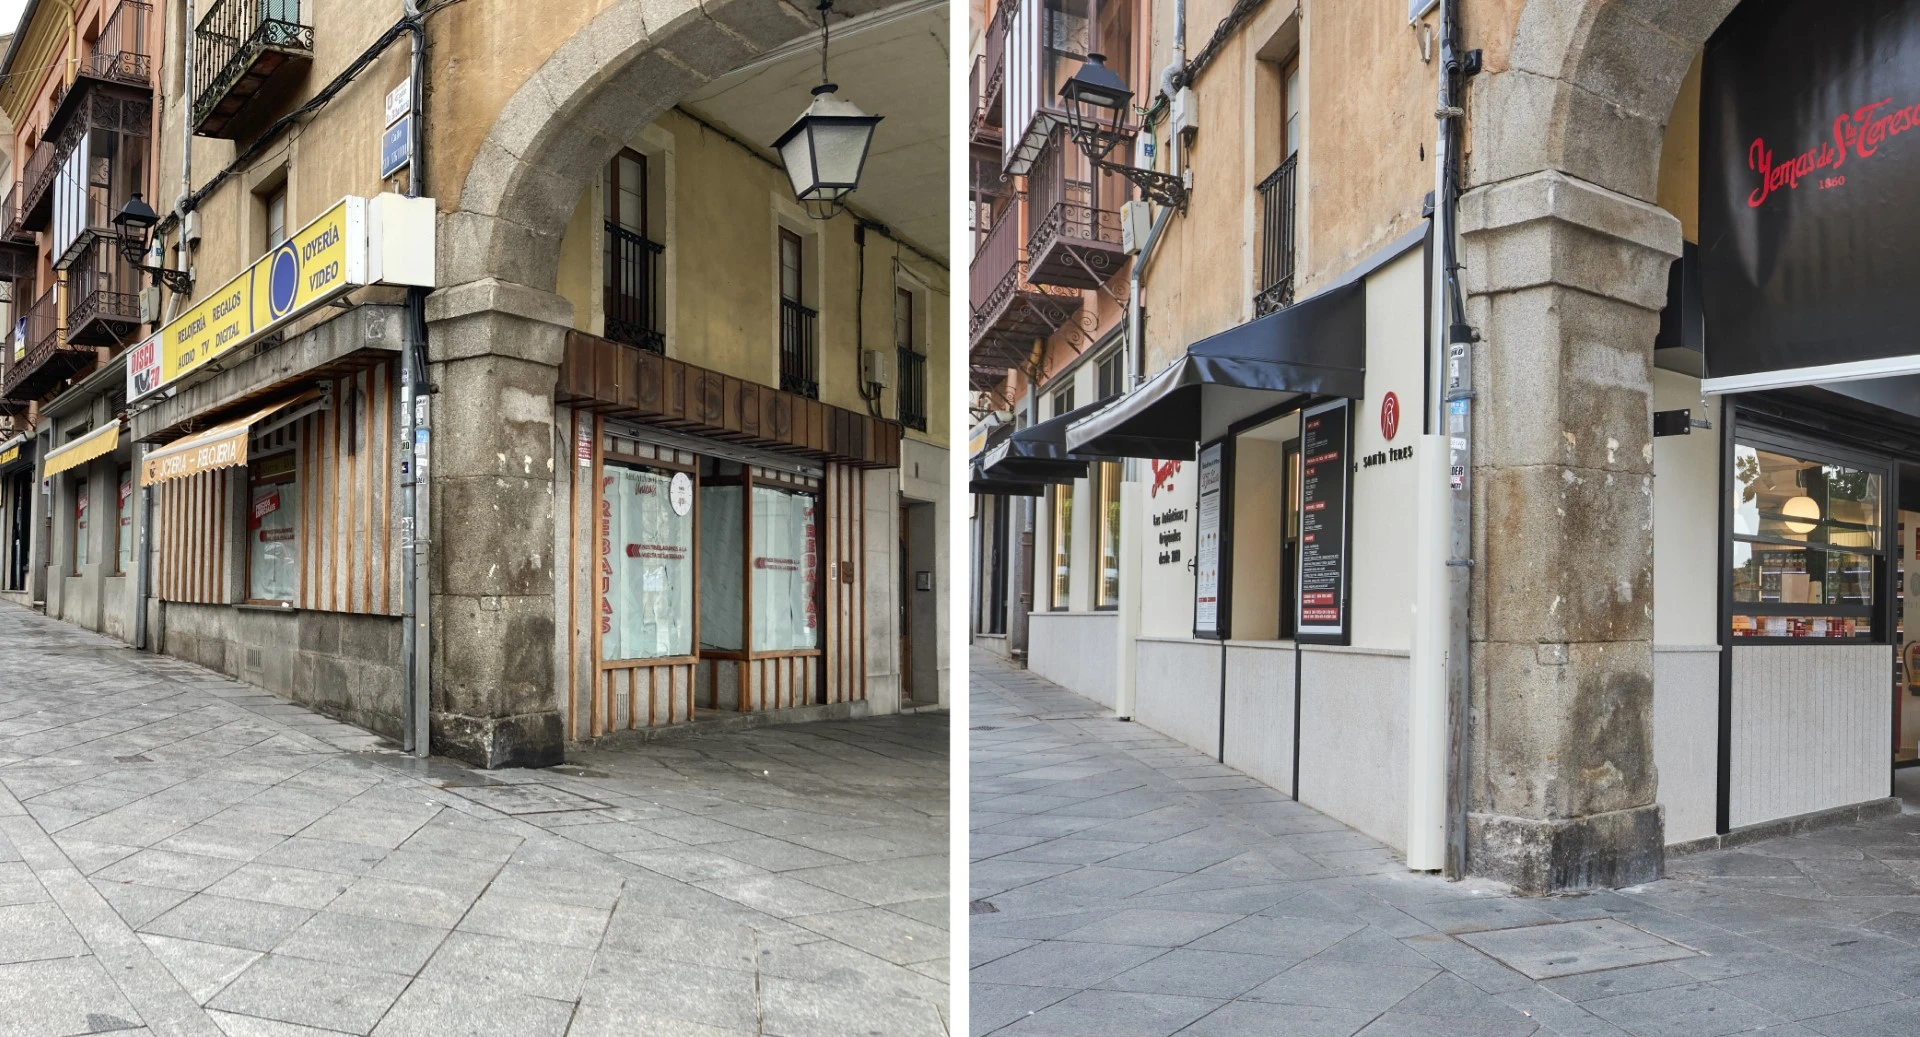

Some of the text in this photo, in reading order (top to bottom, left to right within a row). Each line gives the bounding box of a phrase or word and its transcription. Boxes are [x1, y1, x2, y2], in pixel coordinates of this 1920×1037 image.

[1748, 137, 1818, 208] Yemas
[1816, 141, 1834, 169] de
[1817, 175, 1846, 190] 1860
[302, 222, 340, 270] JOYERÍA
[309, 260, 339, 292] VIDEO
[177, 291, 241, 345] RELOJERÍA REGALOS
[131, 341, 154, 376] DISCO
[177, 321, 240, 370] AUDIO TV DIGITAL
[160, 453, 187, 477] JOYERIA
[197, 440, 237, 469] RELOJERIA
[601, 500, 613, 634] REBAJAS
